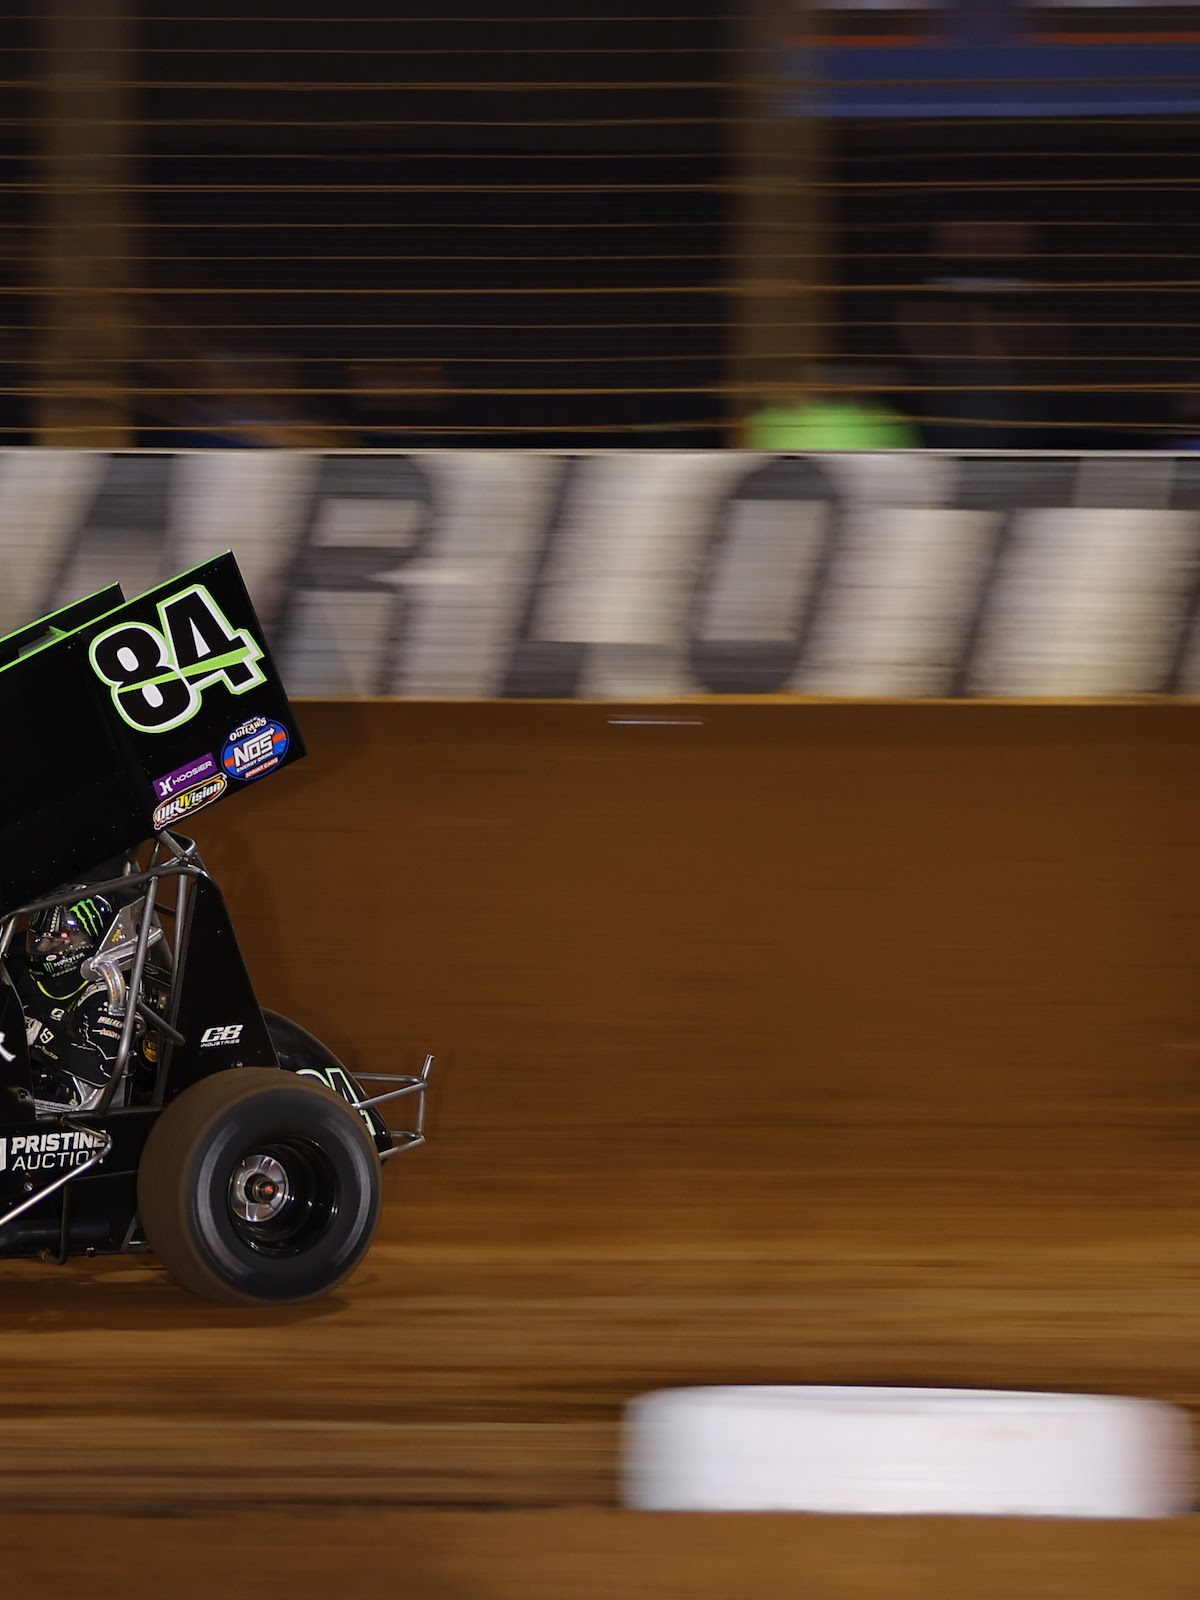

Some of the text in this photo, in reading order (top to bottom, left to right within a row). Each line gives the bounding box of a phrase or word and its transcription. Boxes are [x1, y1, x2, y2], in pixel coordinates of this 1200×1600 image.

[89, 584, 266, 734] 84
[229, 717, 267, 741] OUTLAWS
[233, 726, 275, 767] NOS
[172, 760, 212, 785] HOOSIER
[11, 1130, 107, 1155] PRISTINE
